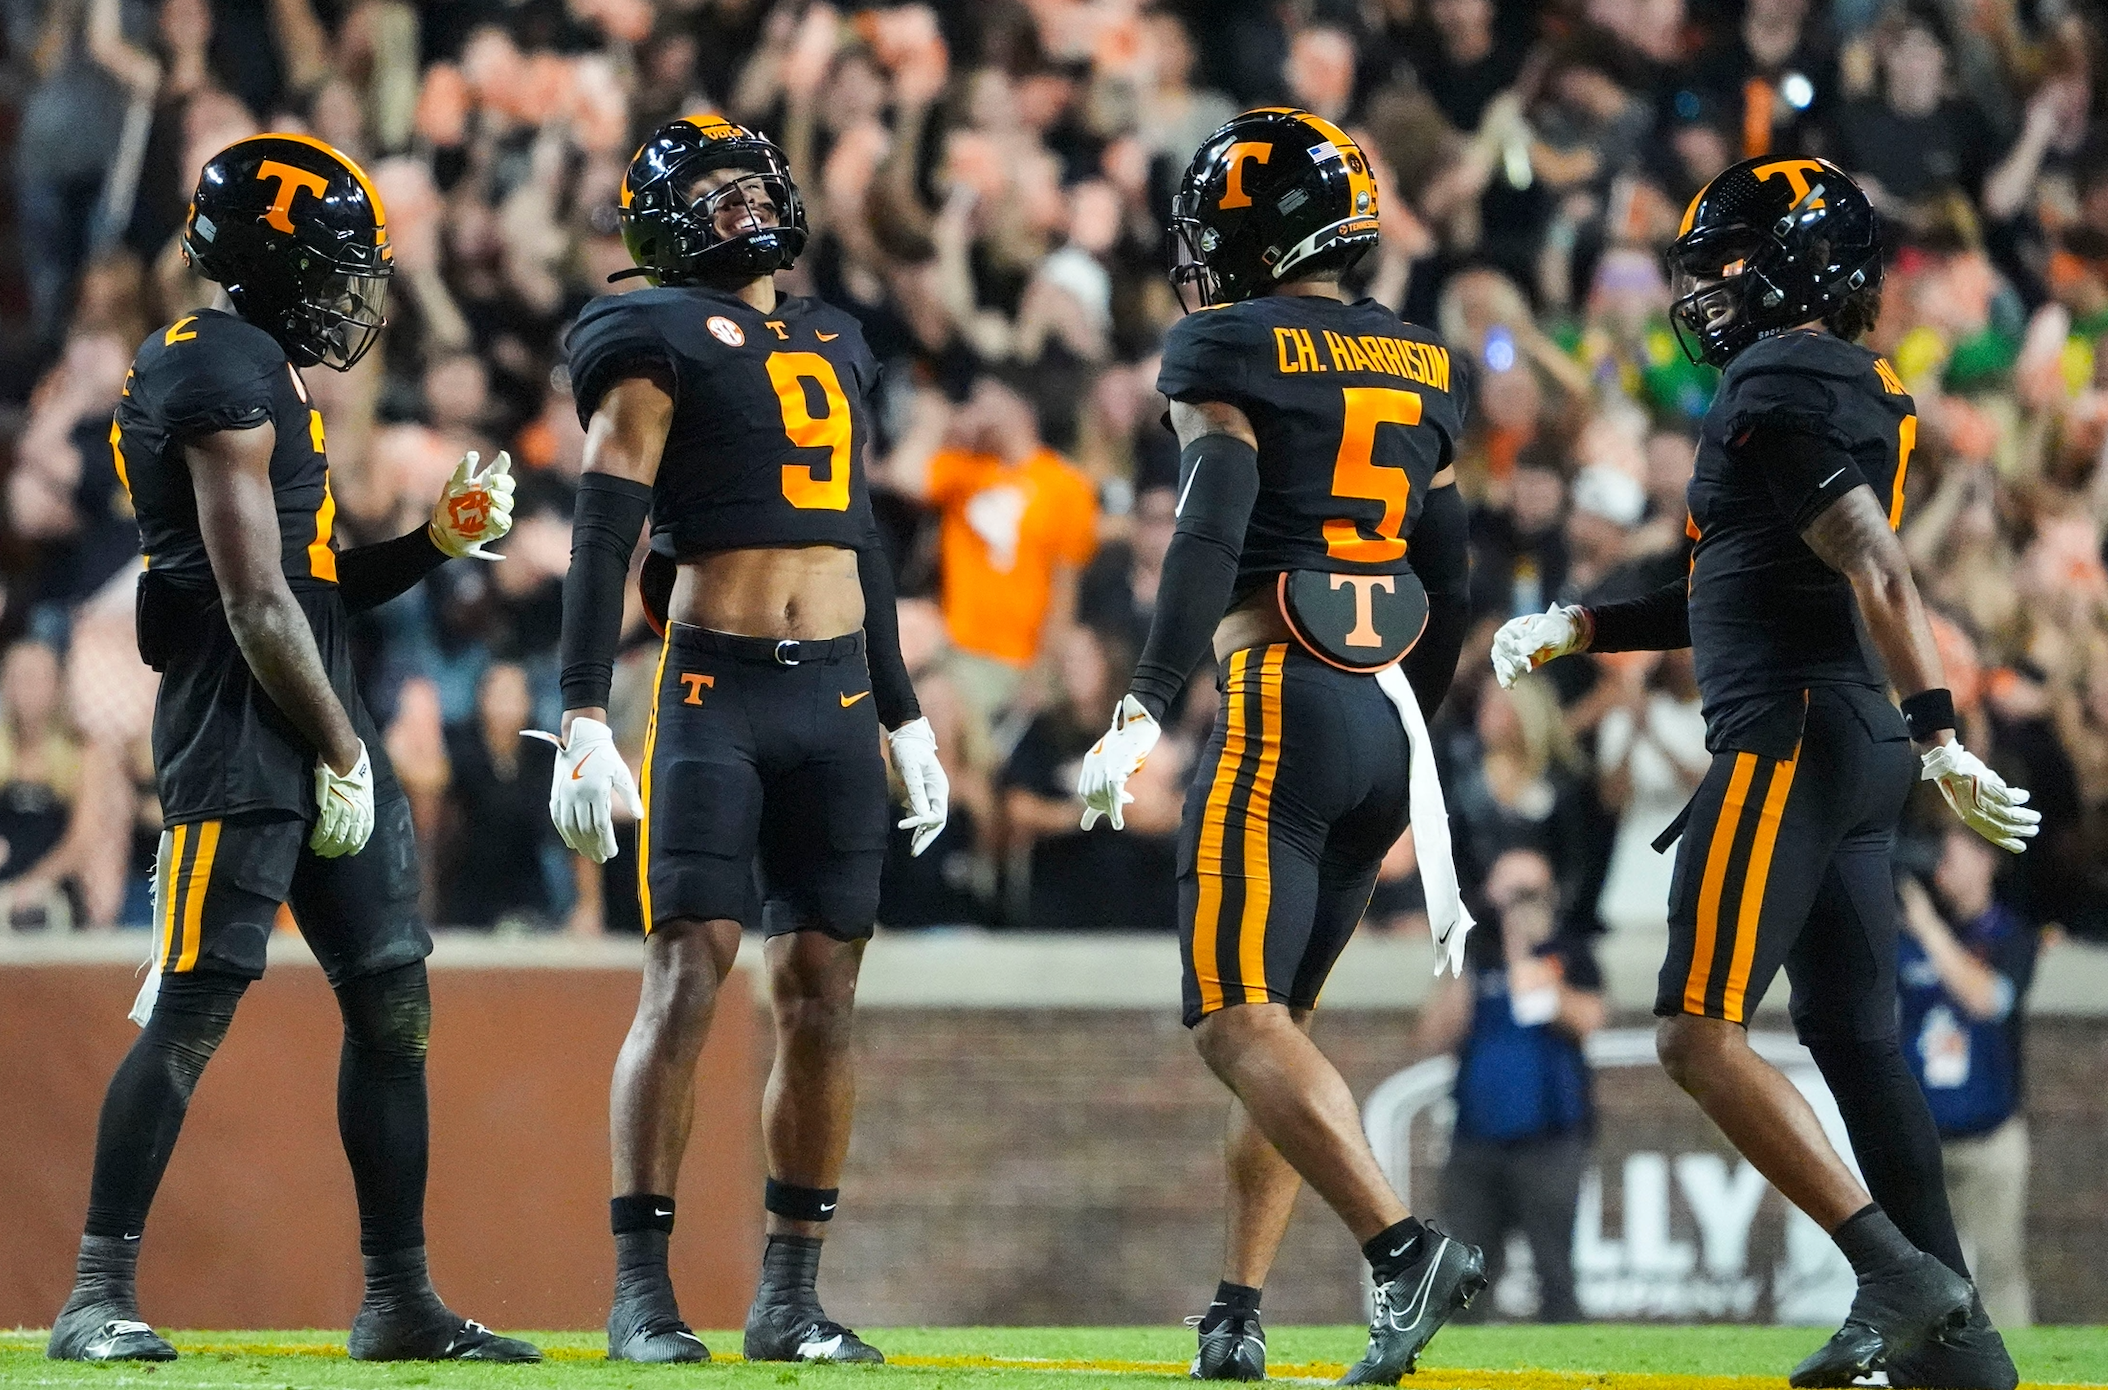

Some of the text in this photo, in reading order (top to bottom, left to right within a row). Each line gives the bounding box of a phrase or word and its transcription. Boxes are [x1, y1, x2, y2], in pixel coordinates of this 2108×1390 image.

[706, 127, 744, 141] VOLS
[256, 160, 330, 235] T
[1219, 141, 1274, 210] T
[1752, 159, 1827, 212] T
[764, 321, 790, 340] T
[1273, 327, 1450, 393] CH. HARRISON
[764, 351, 853, 512] 9
[1322, 387, 1423, 563] 5
[1330, 573, 1396, 648] T
[680, 672, 715, 706] T
[1573, 1152, 1769, 1276] LLY
